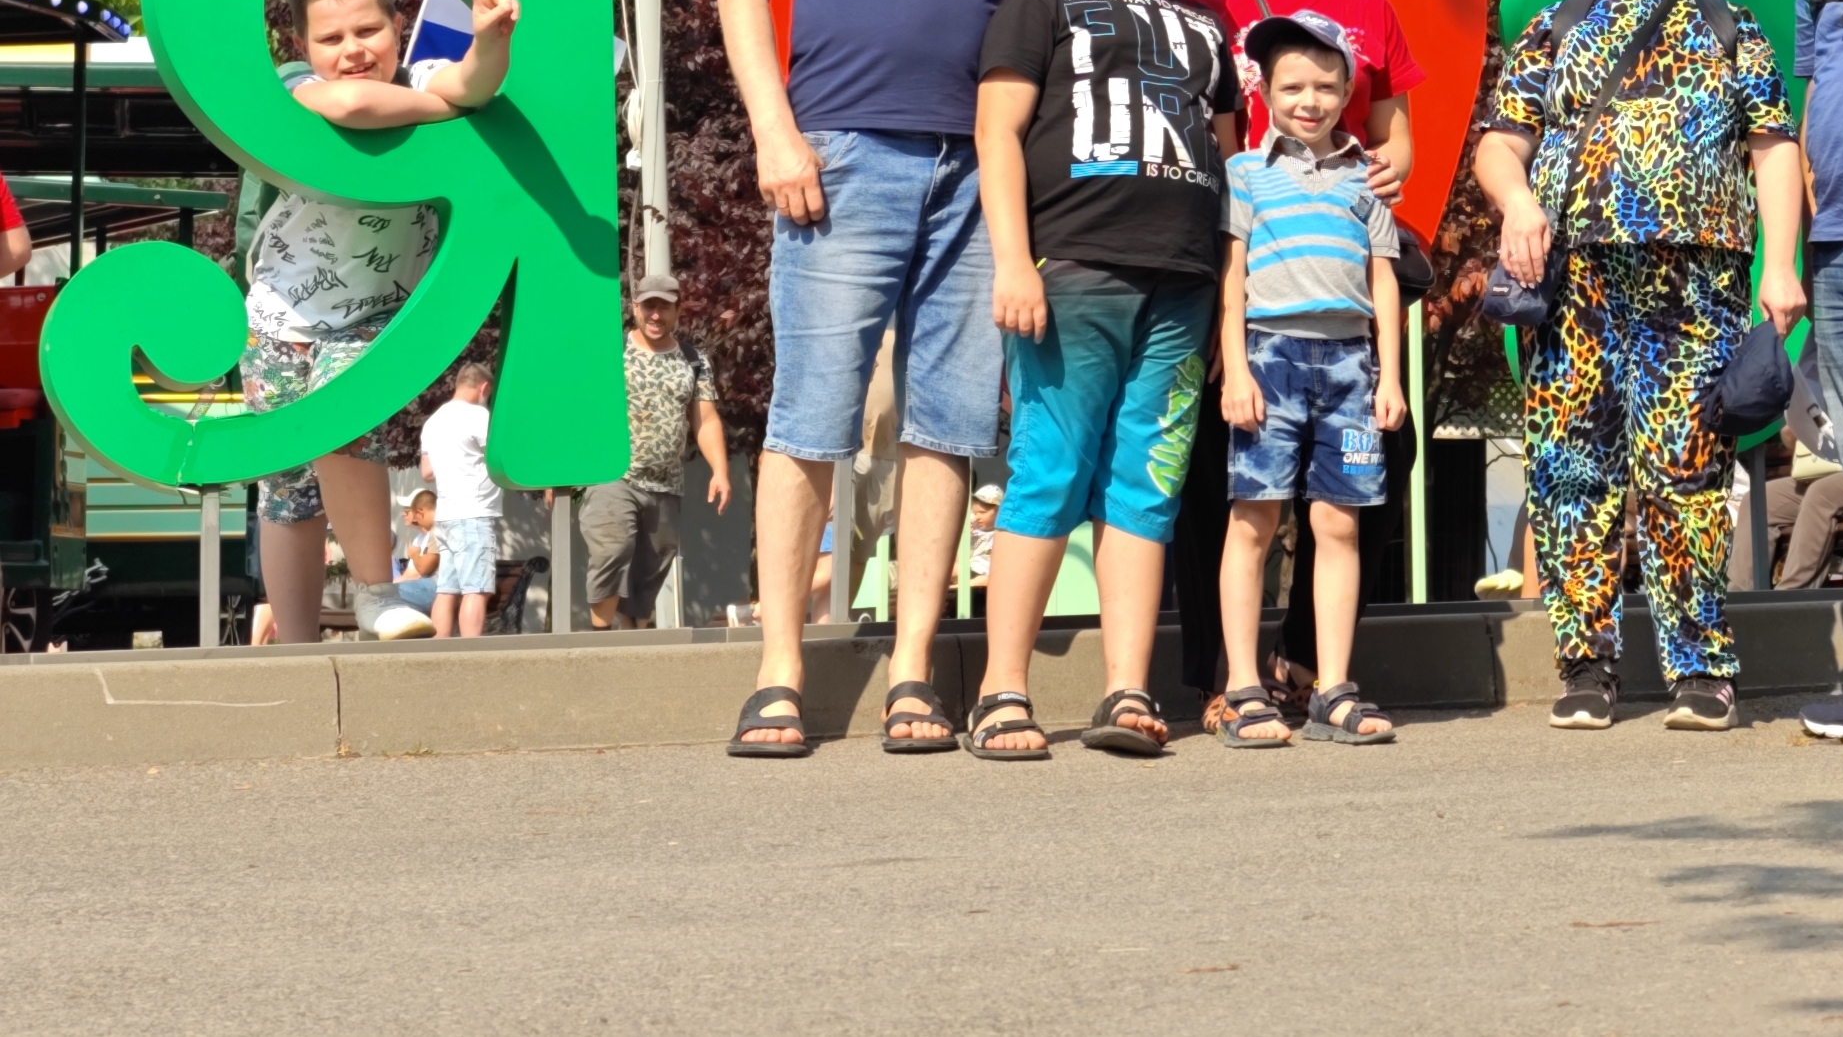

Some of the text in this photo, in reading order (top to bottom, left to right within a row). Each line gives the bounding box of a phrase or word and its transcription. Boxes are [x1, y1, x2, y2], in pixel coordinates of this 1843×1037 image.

[1146, 163, 1159, 177] IS
[1162, 164, 1182, 180] TO
[1342, 452, 1370, 464] ONE
